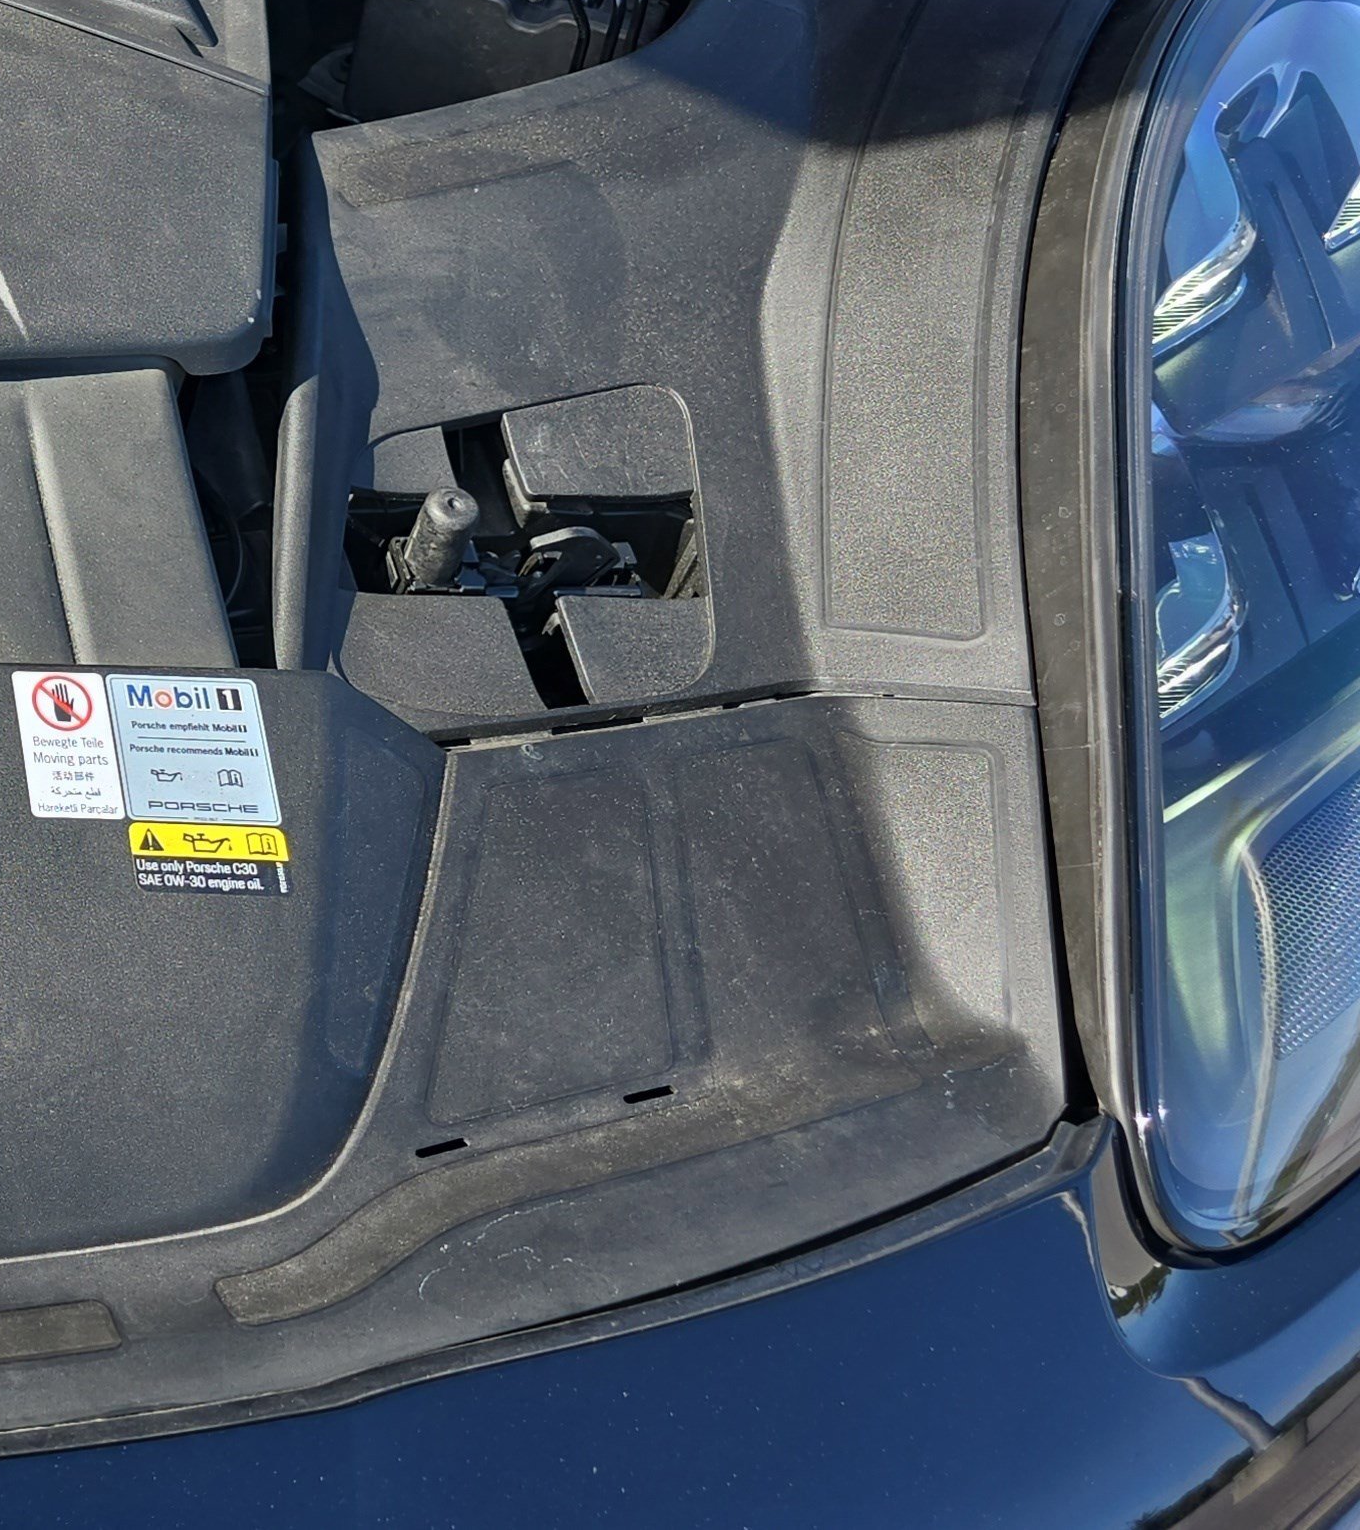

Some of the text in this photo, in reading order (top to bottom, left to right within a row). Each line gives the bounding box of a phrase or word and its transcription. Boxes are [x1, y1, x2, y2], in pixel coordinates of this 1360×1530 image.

[126, 684, 237, 710] Mobil 1
[131, 721, 168, 730] Porsche
[169, 723, 210, 732] empfiehlt
[32, 736, 105, 749] Bewegte Teile
[129, 744, 165, 753] Porsche
[166, 747, 224, 756] recommends
[33, 751, 109, 766] Moving parts
[148, 801, 259, 814] PORSCHE
[136, 859, 258, 875] Use only Porsche C30
[138, 874, 265, 892] SAE 0W-30 engine oil.
